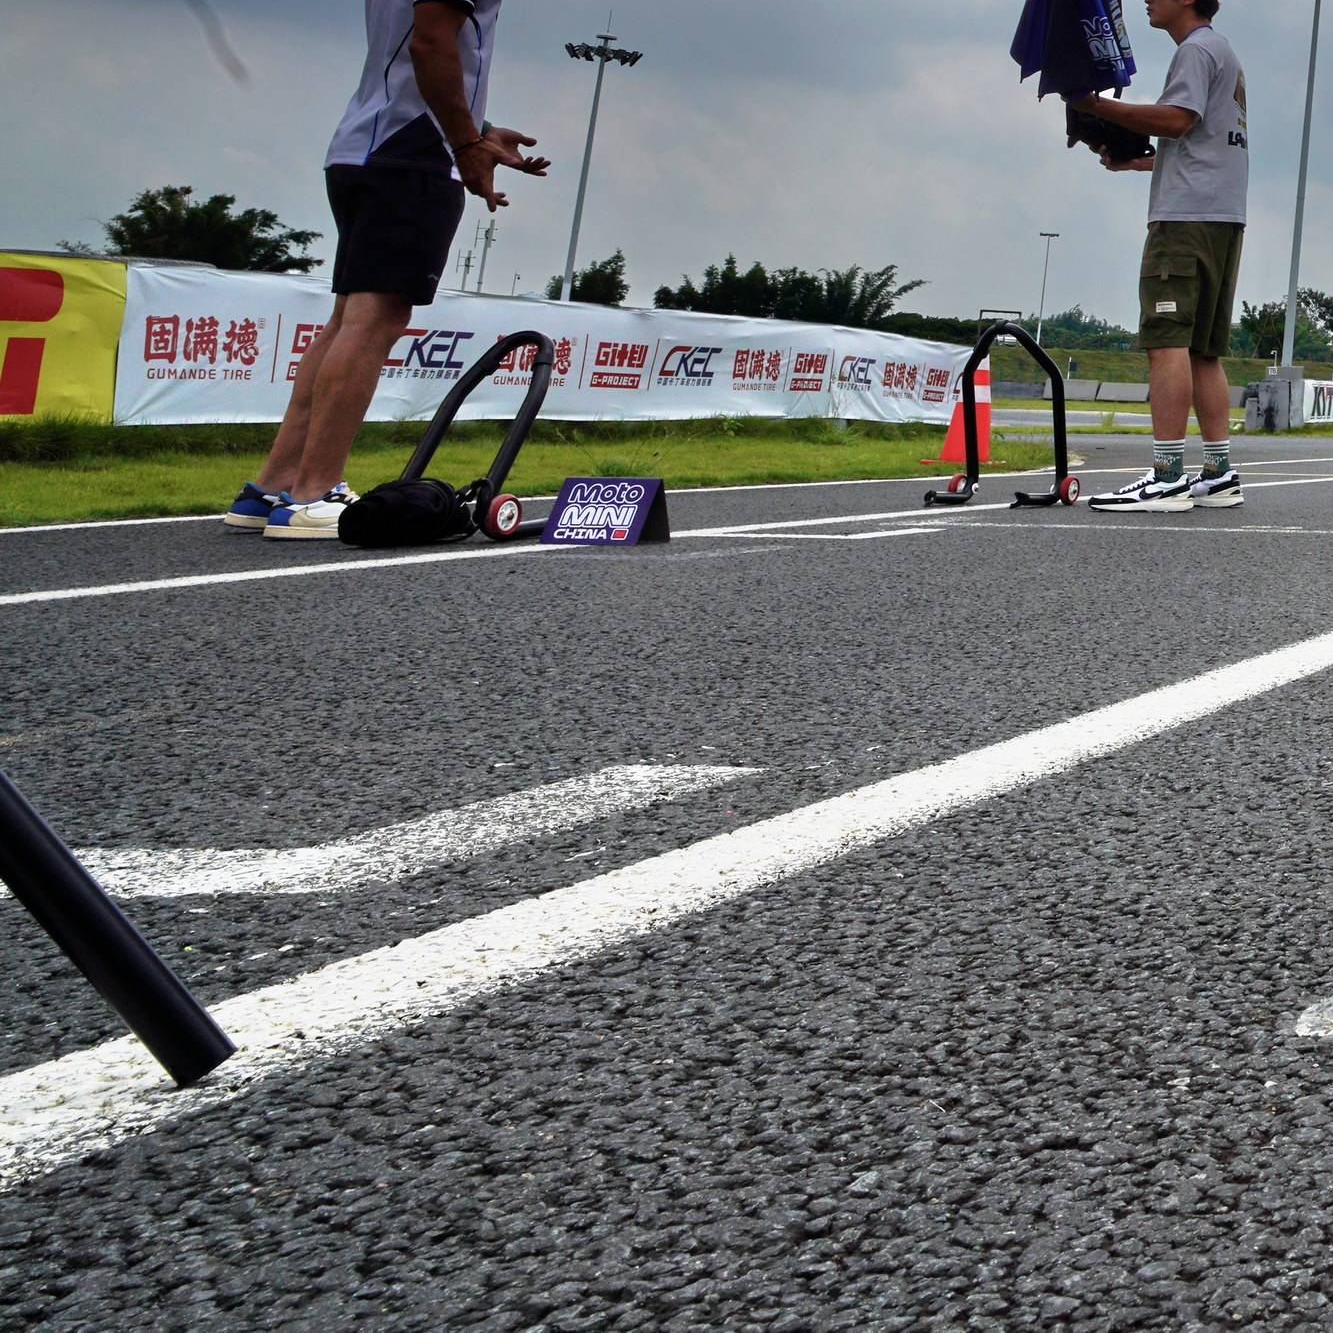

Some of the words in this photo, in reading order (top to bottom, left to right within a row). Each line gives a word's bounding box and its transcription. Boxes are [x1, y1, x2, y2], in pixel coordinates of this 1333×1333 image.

[144, 315, 259, 366] 固满德
[659, 346, 723, 377] CKEC
[147, 368, 217, 380] GUMANDE
[223, 369, 252, 380] TIRE
[592, 375, 640, 386] G-PROJECT
[733, 382, 761, 392] GUMANDE
[763, 383, 776, 392] TIRE
[567, 482, 645, 504] Moto
[558, 503, 638, 528] MINI
[553, 528, 607, 540] CHINA
